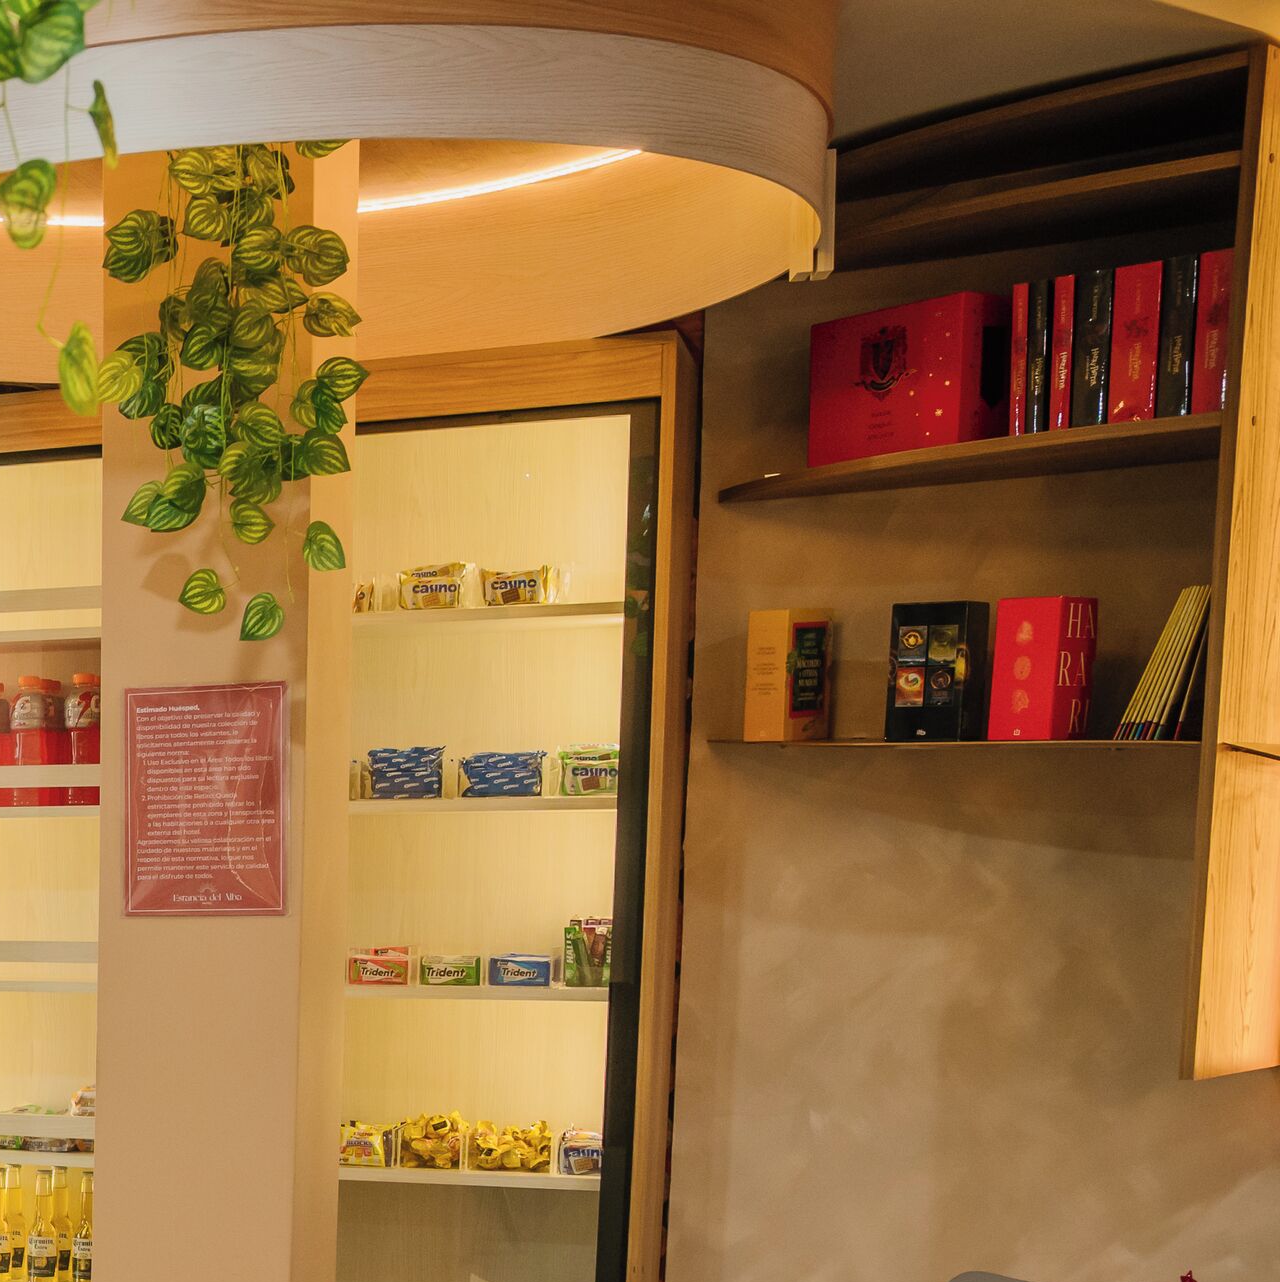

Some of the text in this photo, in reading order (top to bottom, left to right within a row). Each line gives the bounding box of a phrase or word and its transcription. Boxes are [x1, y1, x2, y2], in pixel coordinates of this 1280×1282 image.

[412, 584, 457, 593] casino
[491, 578, 537, 591] casino
[1057, 651, 1087, 687] RA
[572, 768, 618, 777] casino
[209, 893, 221, 901] del
[361, 967, 395, 976] Trident
[426, 968, 465, 977] Trident
[502, 968, 536, 977] Trident
